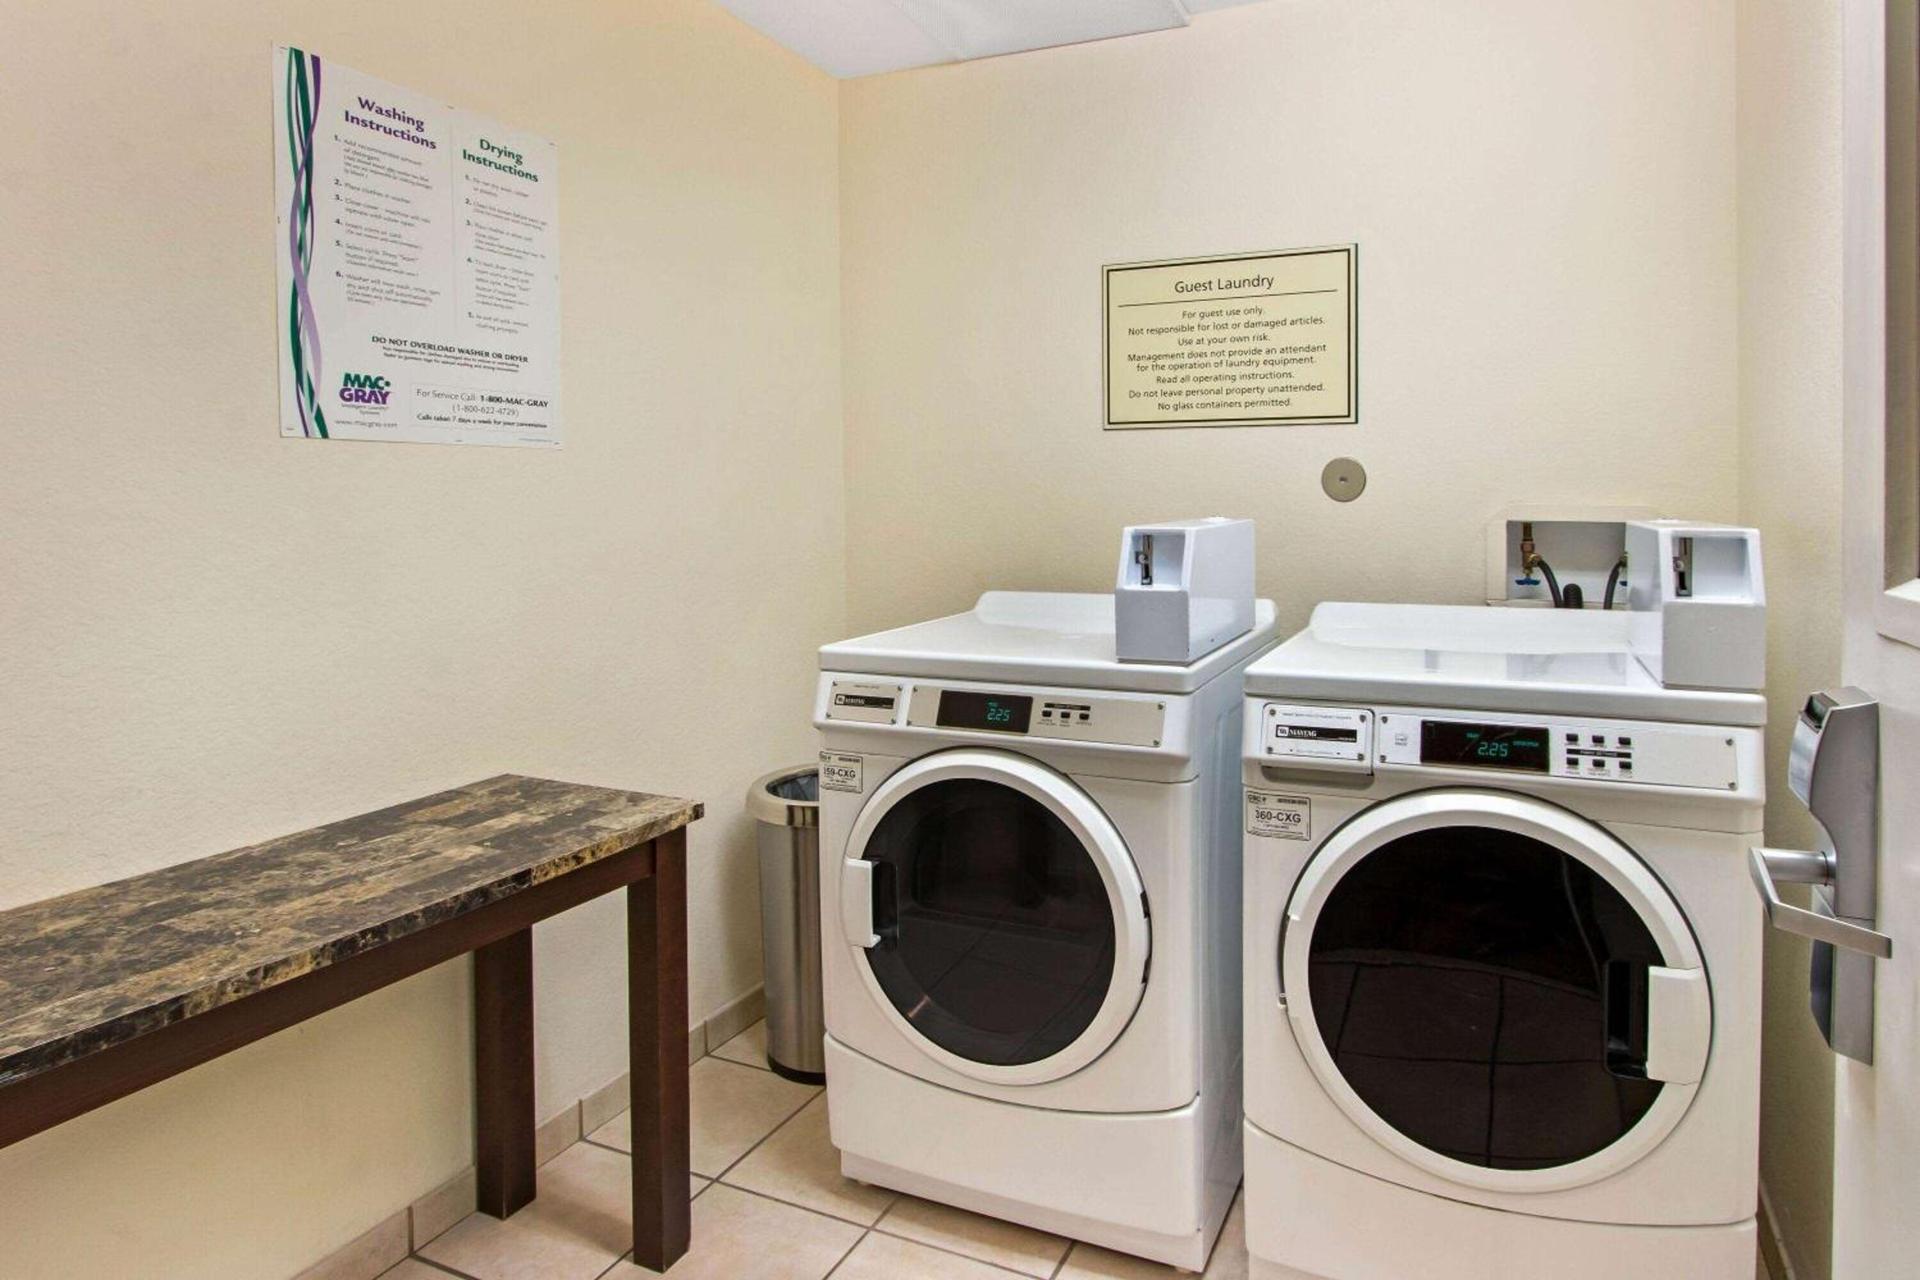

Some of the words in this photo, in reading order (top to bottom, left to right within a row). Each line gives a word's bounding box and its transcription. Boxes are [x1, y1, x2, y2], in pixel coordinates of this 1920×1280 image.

[358, 96, 424, 132] Washing
[344, 110, 437, 149] Instructions
[480, 138, 523, 166] Drying
[463, 148, 539, 183] Instructions
[334, 178, 342, 187] 2.
[465, 197, 472, 206] 2.
[1174, 280, 1212, 293] Guest
[1217, 274, 1274, 290] Laundry
[1182, 310, 1196, 318] For
[1199, 308, 1223, 320] guest
[1226, 308, 1240, 316] use
[1128, 327, 1144, 336] Not
[1146, 323, 1195, 336] responsible
[1198, 322, 1210, 332] for
[1213, 321, 1229, 330] lost
[1231, 322, 1241, 330] or
[1243, 317, 1287, 330] damaged
[1289, 315, 1325, 326] articles.
[1178, 336, 1193, 346] Use
[1196, 336, 1205, 345] at
[1207, 337, 1227, 346] your
[1229, 335, 1250, 343] own
[1252, 332, 1271, 342] risk.
[371, 335, 386, 344] DO
[388, 338, 408, 347] NOT
[410, 341, 456, 353] OVERLOAD
[457, 347, 490, 358] WASHER
[491, 352, 503, 360] OR
[504, 354, 529, 363] DRYER
[1127, 352, 1185, 363] Management
[1187, 350, 1208, 359] does
[1210, 349, 1226, 358] not
[1228, 346, 1263, 358] provide
[1265, 347, 1277, 355] an
[1279, 343, 1327, 354] attendant
[1136, 362, 1149, 372] for
[1151, 362, 1166, 371] the
[1168, 359, 1211, 372] operation
[1213, 358, 1224, 368] of
[1225, 357, 1260, 368] laundry
[1156, 374, 1178, 384] Read
[1179, 374, 1191, 384] all
[1192, 371, 1237, 384] operating
[1239, 369, 1295, 380] instructions.
[339, 387, 391, 405] GRAY
[416, 388, 430, 398] For
[432, 389, 459, 400] Service
[480, 394, 548, 407] 1-800-MAC-GRAY
[1128, 389, 1142, 399] Do
[1143, 389, 1159, 398] not
[1160, 388, 1183, 398] leave
[1185, 386, 1224, 397] personal
[1225, 386, 1265, 397] property
[1267, 383, 1325, 394] unattended.
[1157, 402, 1171, 411] No
[1172, 400, 1194, 412] glass
[1195, 398, 1241, 410] containers
[987, 707, 1011, 722] 2.25
[1477, 741, 1508, 757] 2.25
[1255, 809, 1302, 824] 360-CXG
